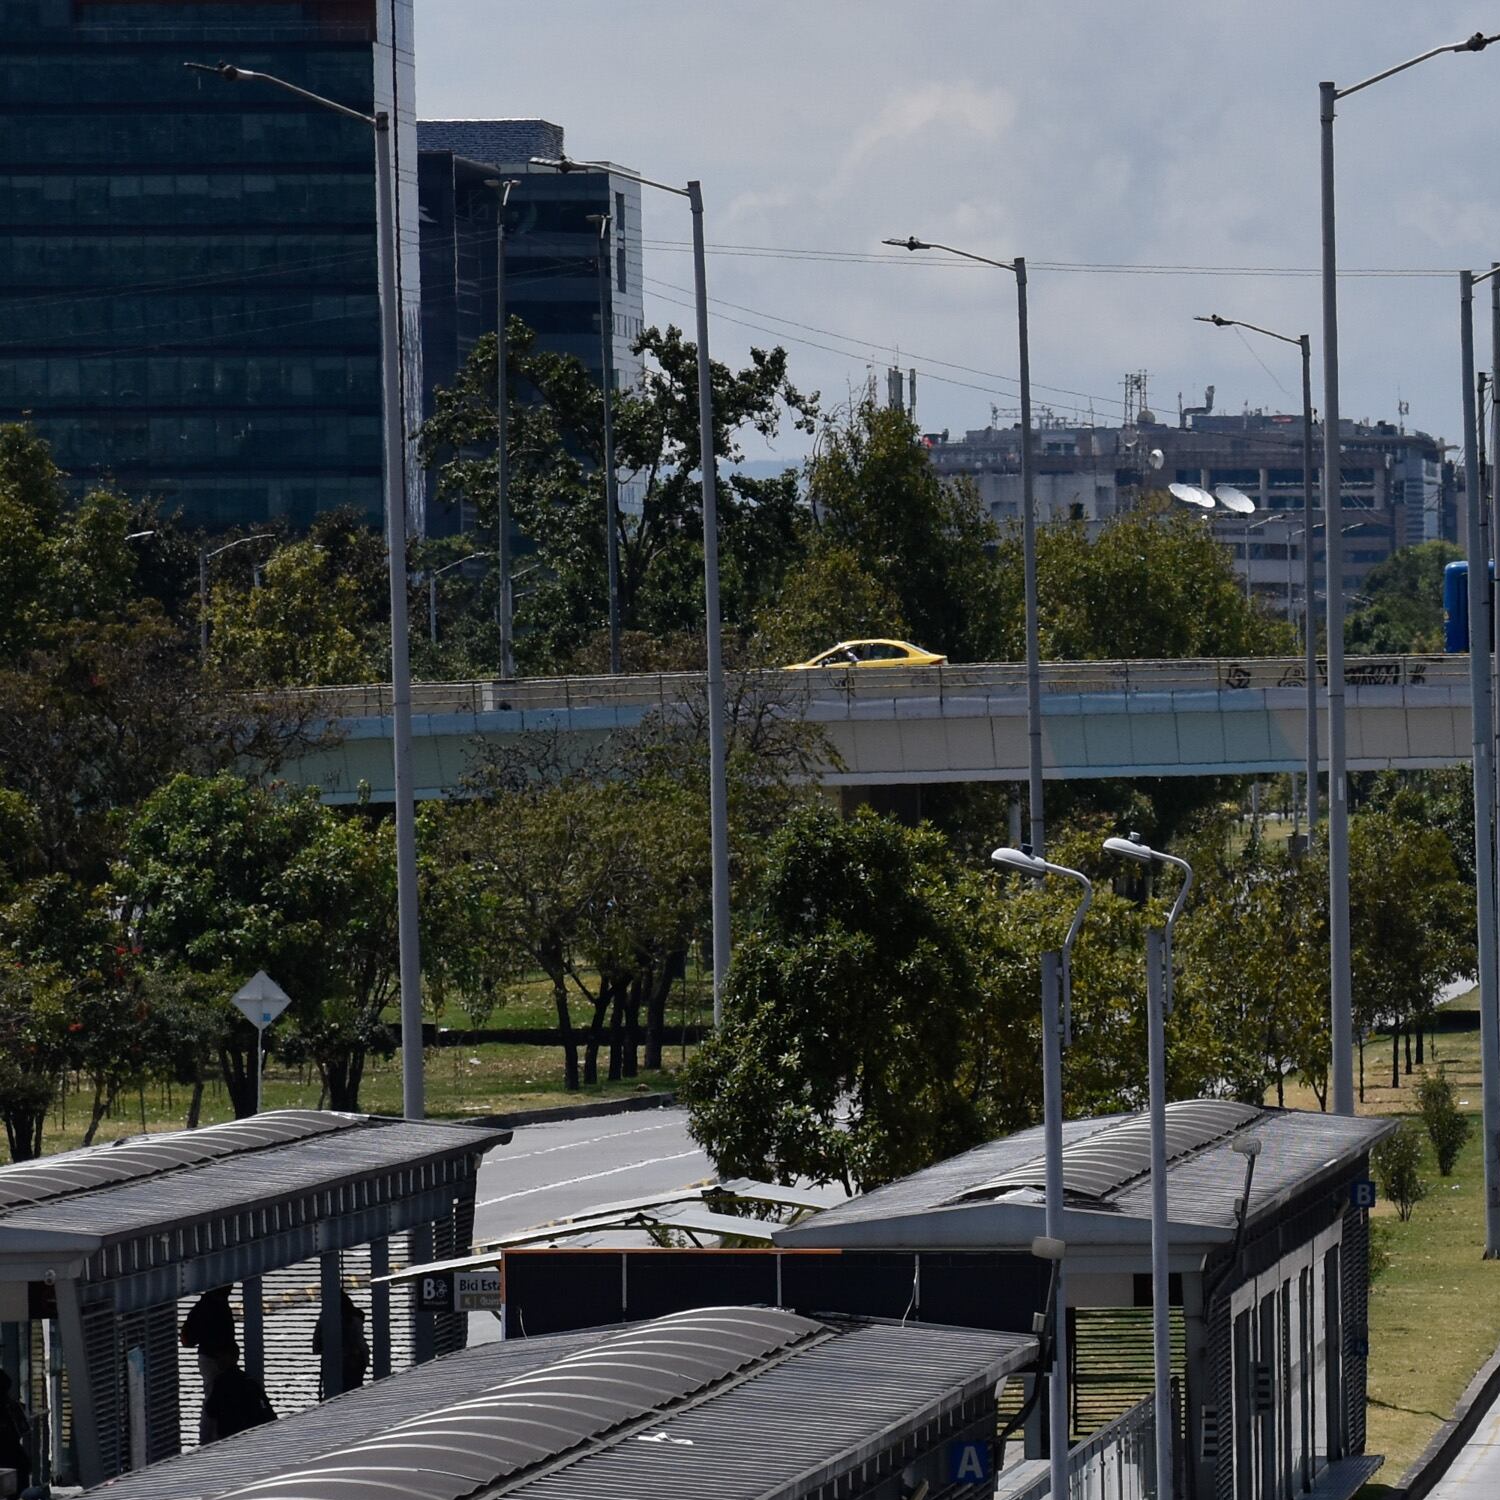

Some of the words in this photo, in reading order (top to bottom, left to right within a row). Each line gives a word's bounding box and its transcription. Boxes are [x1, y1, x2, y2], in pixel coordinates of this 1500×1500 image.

[1357, 1184, 1371, 1204] B
[423, 1278, 436, 1300] B
[460, 1280, 478, 1291] Bici
[957, 1446, 984, 1478] A
